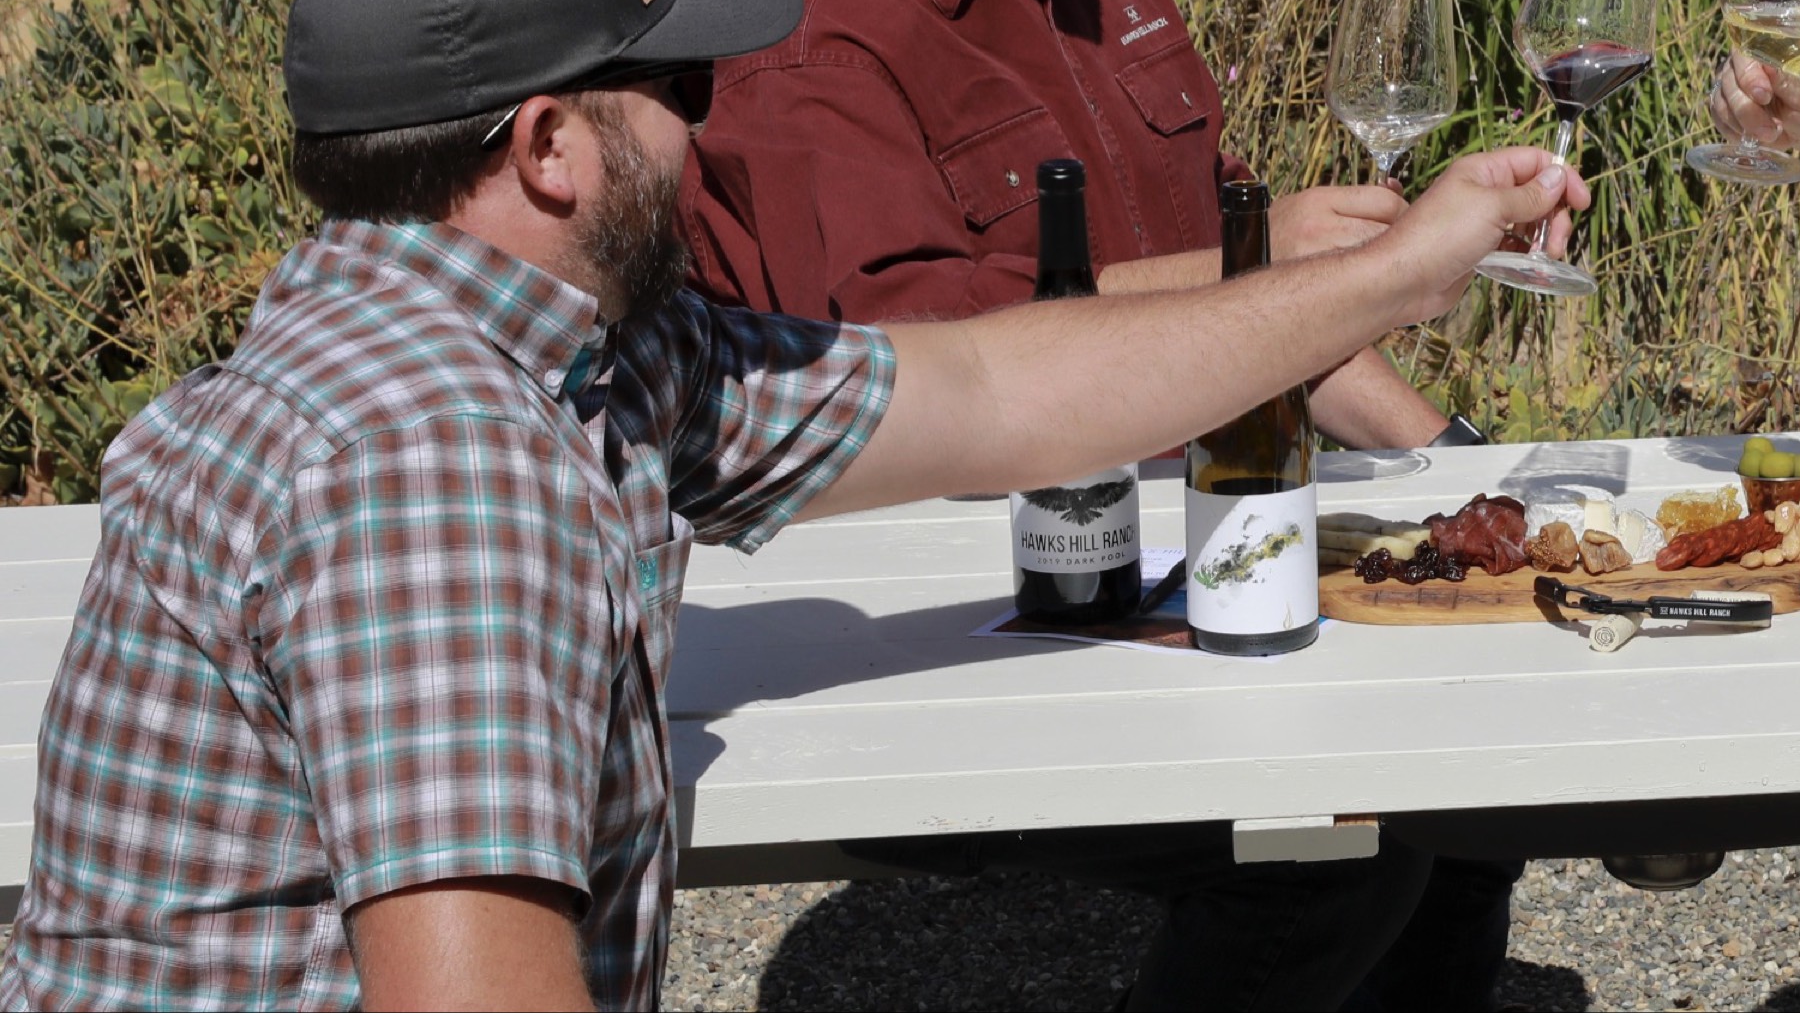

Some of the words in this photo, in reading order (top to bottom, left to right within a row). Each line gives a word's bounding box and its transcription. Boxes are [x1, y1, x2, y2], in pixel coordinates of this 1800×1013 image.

[1021, 530, 1065, 553] HAWKS
[1069, 534, 1099, 553] HILL
[1103, 525, 1135, 549] RANCH
[1037, 557, 1060, 565] 2019
[1066, 558, 1095, 566] DARK
[1101, 551, 1126, 562] POOL
[1669, 607, 1693, 616] HAWKS
[1693, 608, 1707, 617] HILL
[1709, 609, 1731, 617] RANCH
